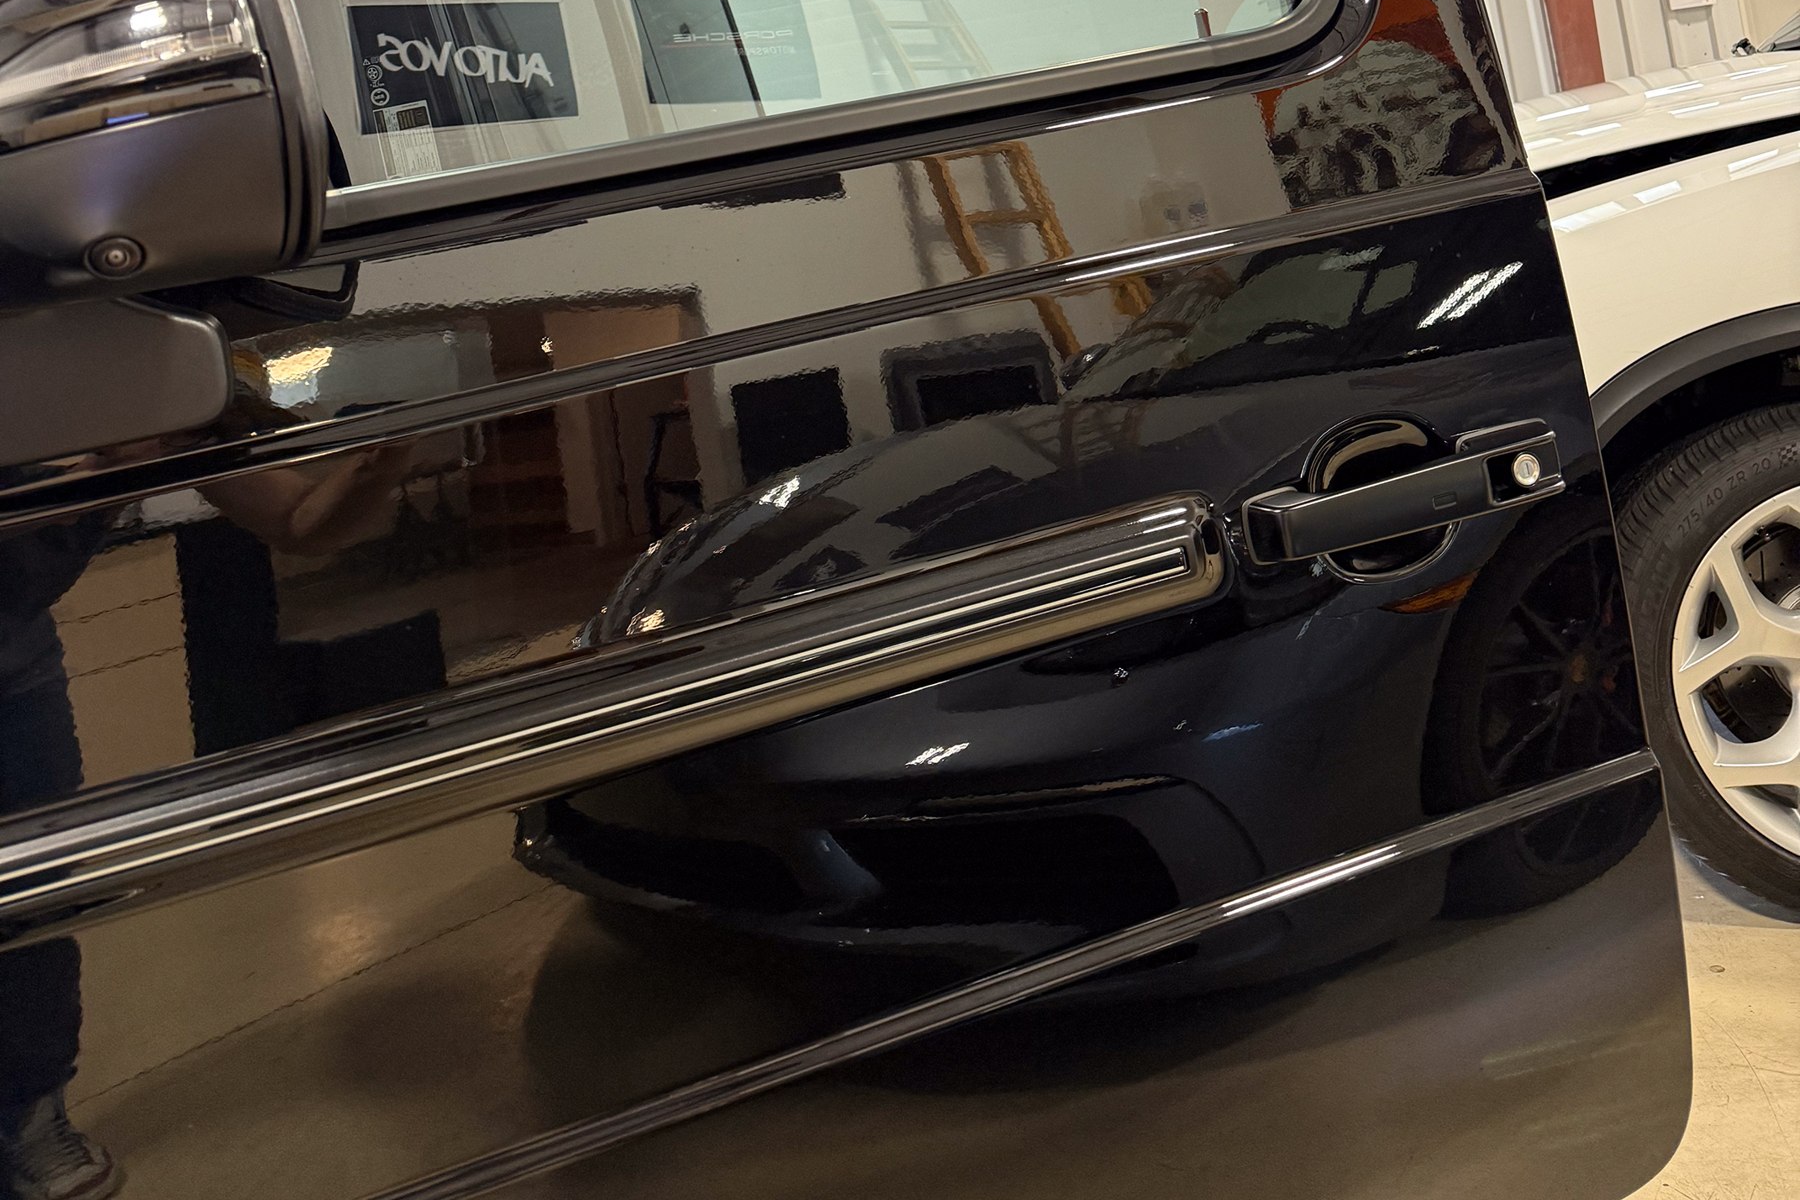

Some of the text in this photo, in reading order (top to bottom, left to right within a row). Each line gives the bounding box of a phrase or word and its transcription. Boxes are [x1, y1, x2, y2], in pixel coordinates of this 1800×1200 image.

[1677, 457, 1771, 538] 275/40 ZR 20
